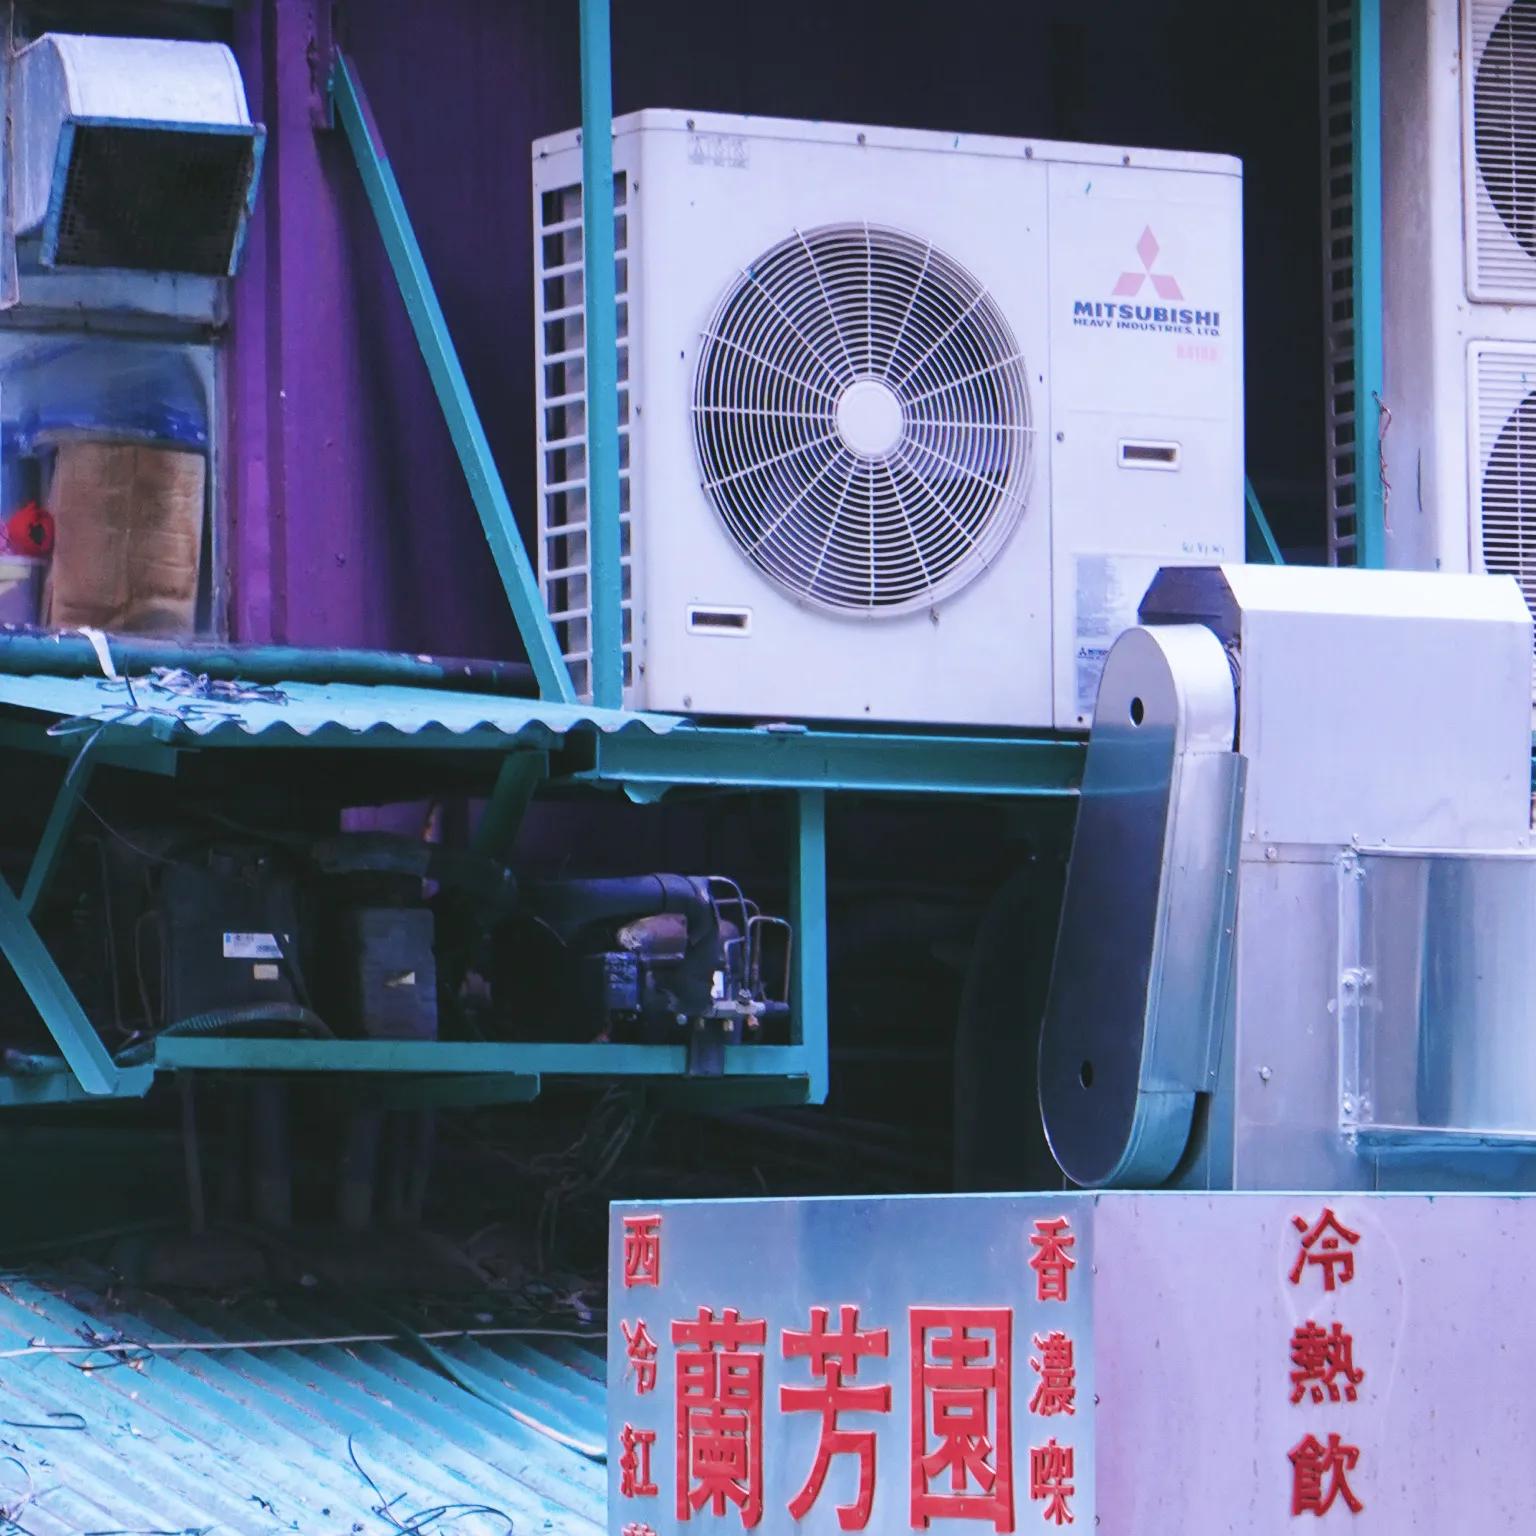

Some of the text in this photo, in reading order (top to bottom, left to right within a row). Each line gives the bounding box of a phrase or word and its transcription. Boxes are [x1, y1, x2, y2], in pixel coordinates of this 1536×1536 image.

[1073, 301, 1220, 327] MITSUBISHI
[1073, 318, 1113, 328] HEAVY
[670, 1305, 1016, 1534] 蘭芳園
